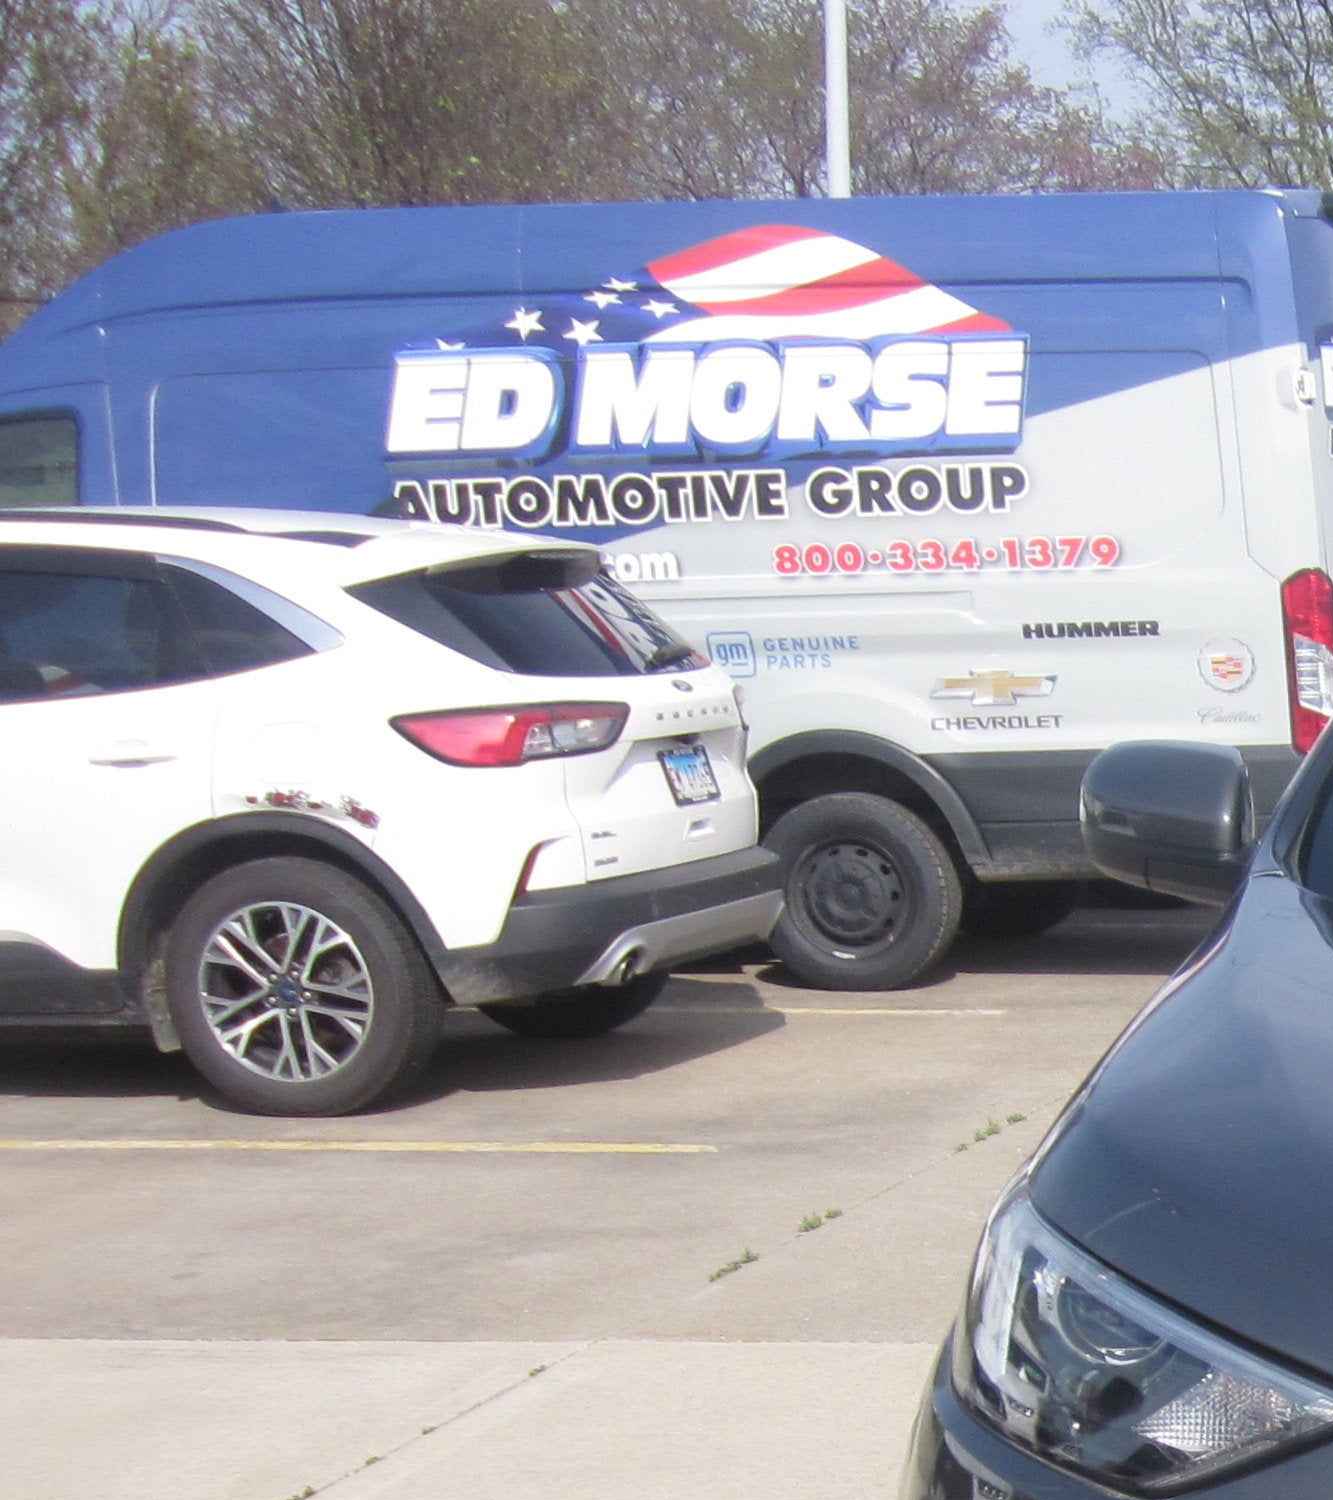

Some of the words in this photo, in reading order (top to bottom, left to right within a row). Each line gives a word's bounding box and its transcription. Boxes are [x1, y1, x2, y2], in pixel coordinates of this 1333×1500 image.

[386, 352, 557, 453] ED
[575, 339, 1027, 449] MORSE
[392, 468, 790, 528] AUTOMOTIVE
[805, 463, 1029, 518] GROUP
[1022, 620, 1160, 639] HUMMER
[763, 635, 860, 651] GENUINE
[715, 642, 749, 667] gm
[767, 653, 832, 669] PARTS
[930, 714, 1063, 731] CHEVROLET
